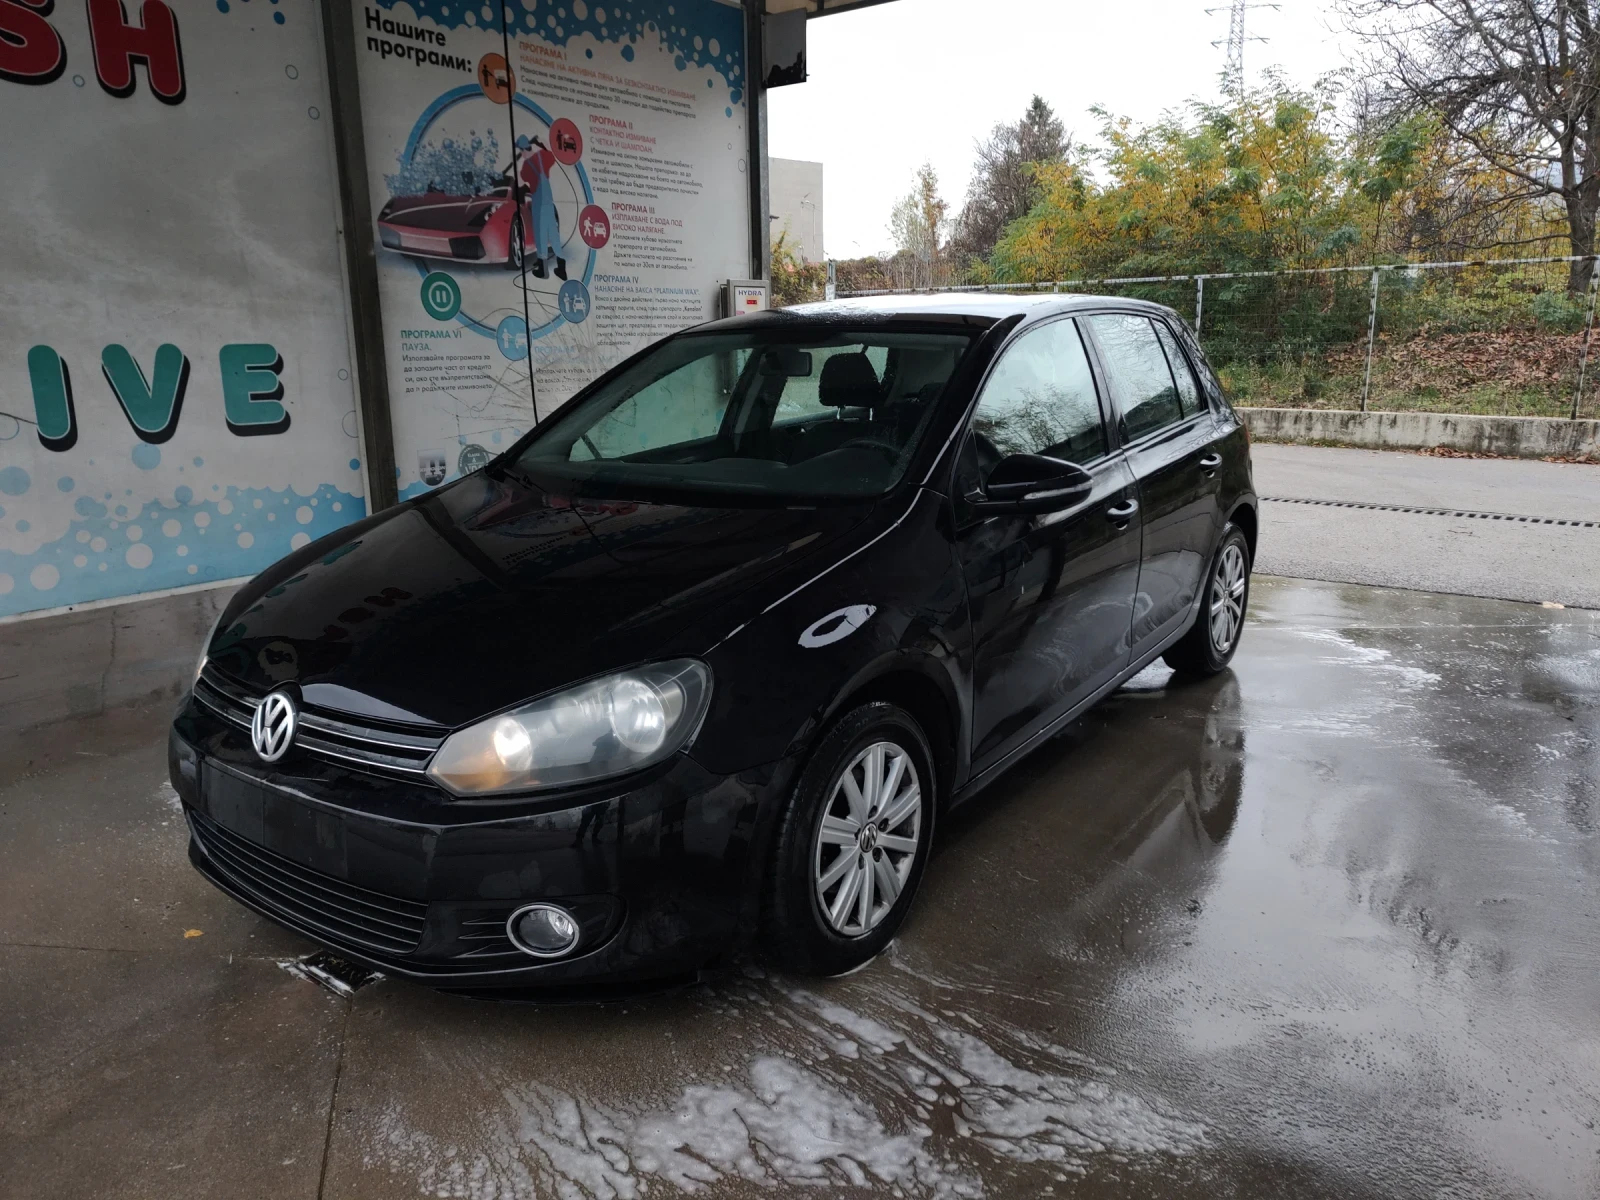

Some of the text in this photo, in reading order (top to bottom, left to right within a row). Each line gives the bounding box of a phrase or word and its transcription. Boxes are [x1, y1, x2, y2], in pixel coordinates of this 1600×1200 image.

[364, 5, 446, 46] Нашите
[366, 35, 472, 73] програми:
[519, 42, 563, 60] ПРОГРАМА
[557, 63, 565, 72] НА
[616, 77, 623, 85] ЗА
[589, 115, 633, 130] ПРОГРАМА II
[590, 126, 656, 144] КОНТАКТНО ИЗМИВАНЕ
[596, 137, 613, 147] ЧЕТКА
[612, 202, 647, 213] ПРОГРАМА
[612, 213, 648, 223] ИЗПЛАКВАНЕ
[655, 217, 670, 226] ВОДА
[671, 219, 683, 228] ПОД
[613, 223, 636, 232] ВИСОКО
[594, 274, 631, 283] ПРОГРАМА
[401, 330, 451, 338] ПРОГРАМА
